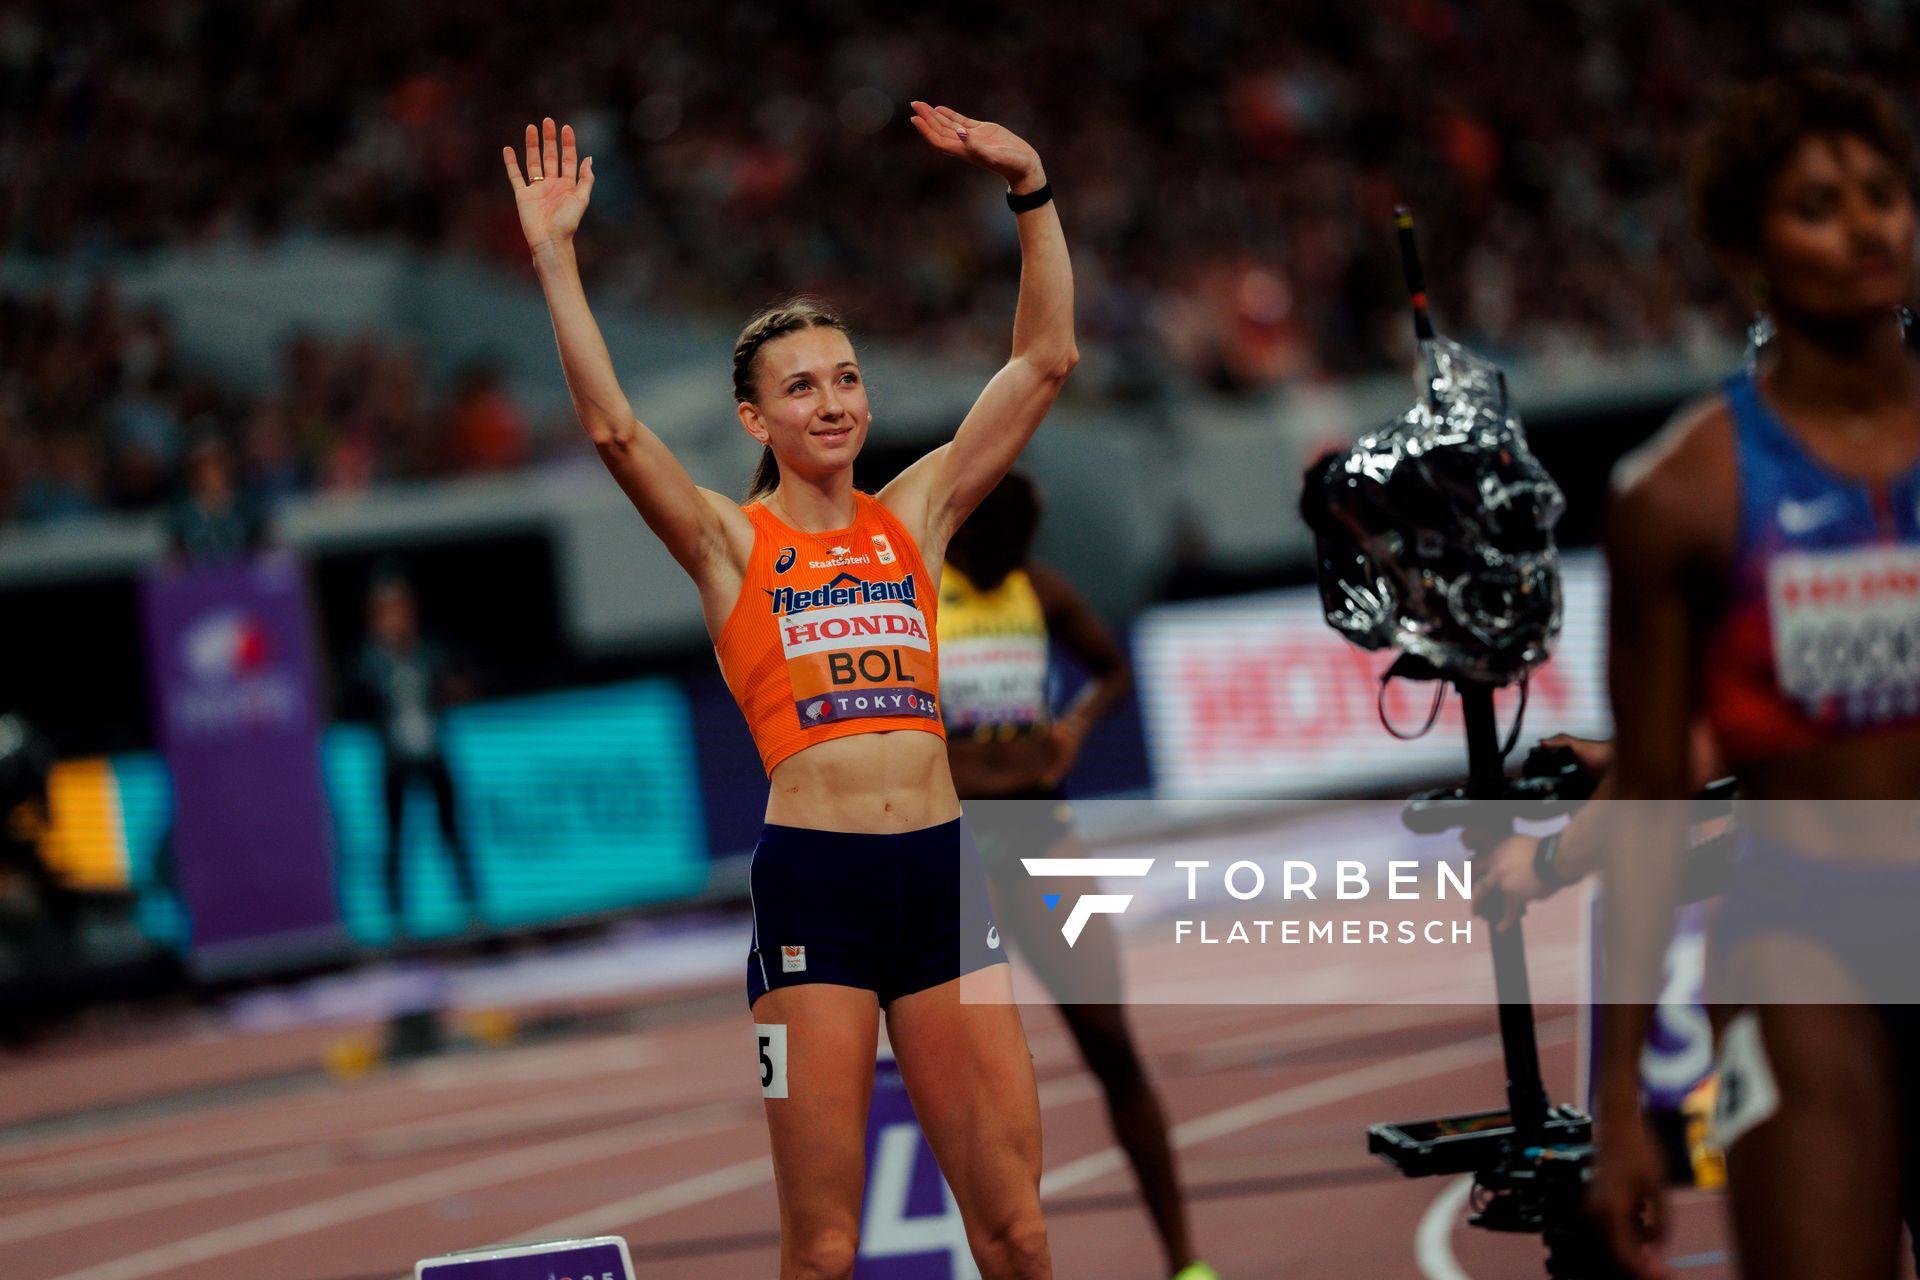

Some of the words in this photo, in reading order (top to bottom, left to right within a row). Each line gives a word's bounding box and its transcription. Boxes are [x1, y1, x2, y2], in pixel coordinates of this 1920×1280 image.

[808, 553, 871, 569] Staatsloterij
[772, 573, 916, 615] Nederland
[784, 614, 928, 647] HONDA
[827, 648, 916, 685] BOL
[757, 1036, 774, 1088] 5
